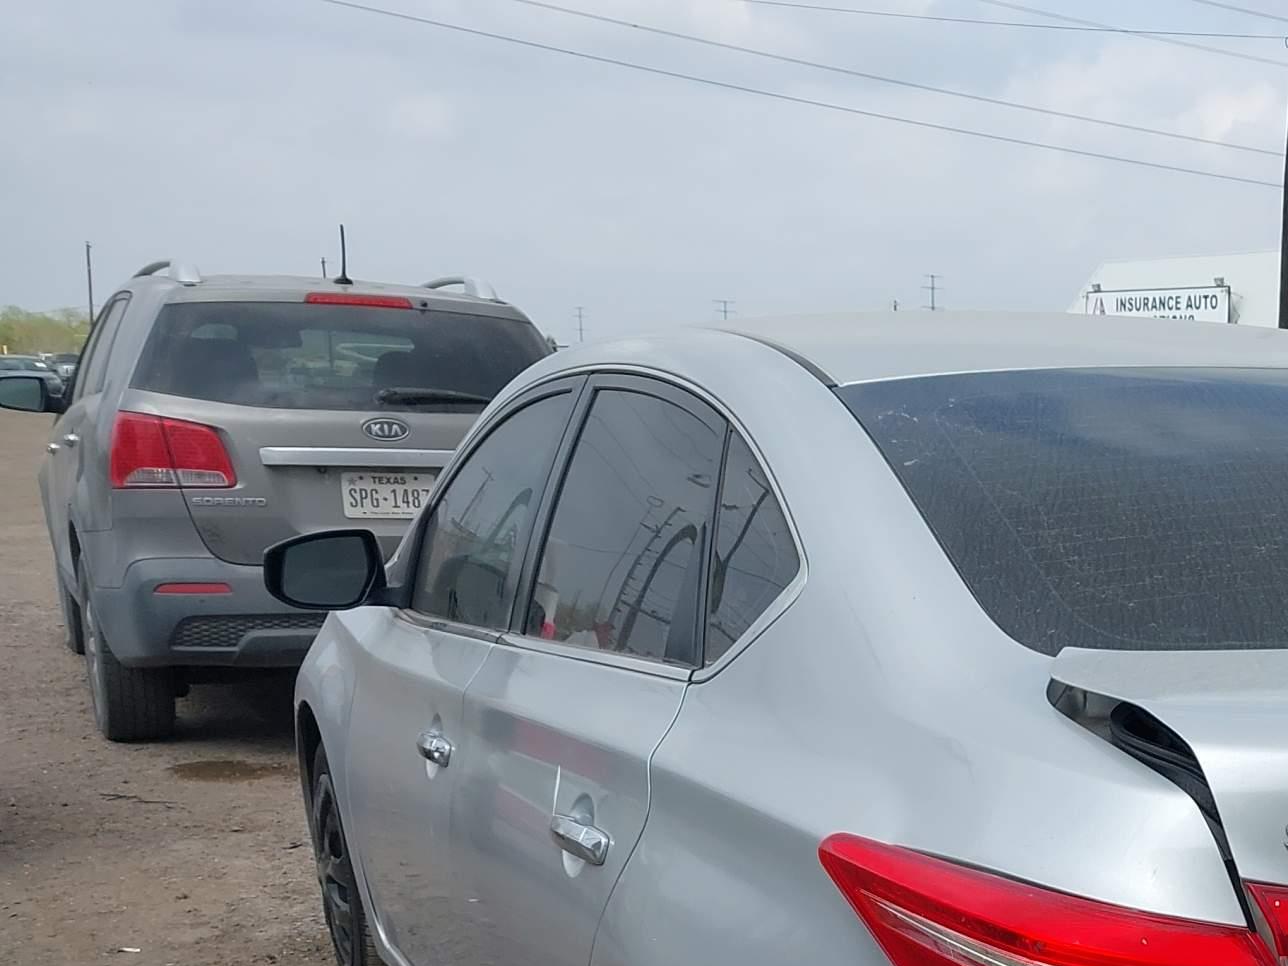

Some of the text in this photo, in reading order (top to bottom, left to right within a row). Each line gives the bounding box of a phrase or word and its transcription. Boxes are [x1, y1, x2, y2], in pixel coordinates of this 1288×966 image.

[1116, 295, 1181, 312] INSURANCE
[1186, 294, 1218, 310] AUTO
[371, 423, 402, 436] KIA
[371, 475, 407, 485] TEXAS
[191, 496, 267, 506] SORENTO
